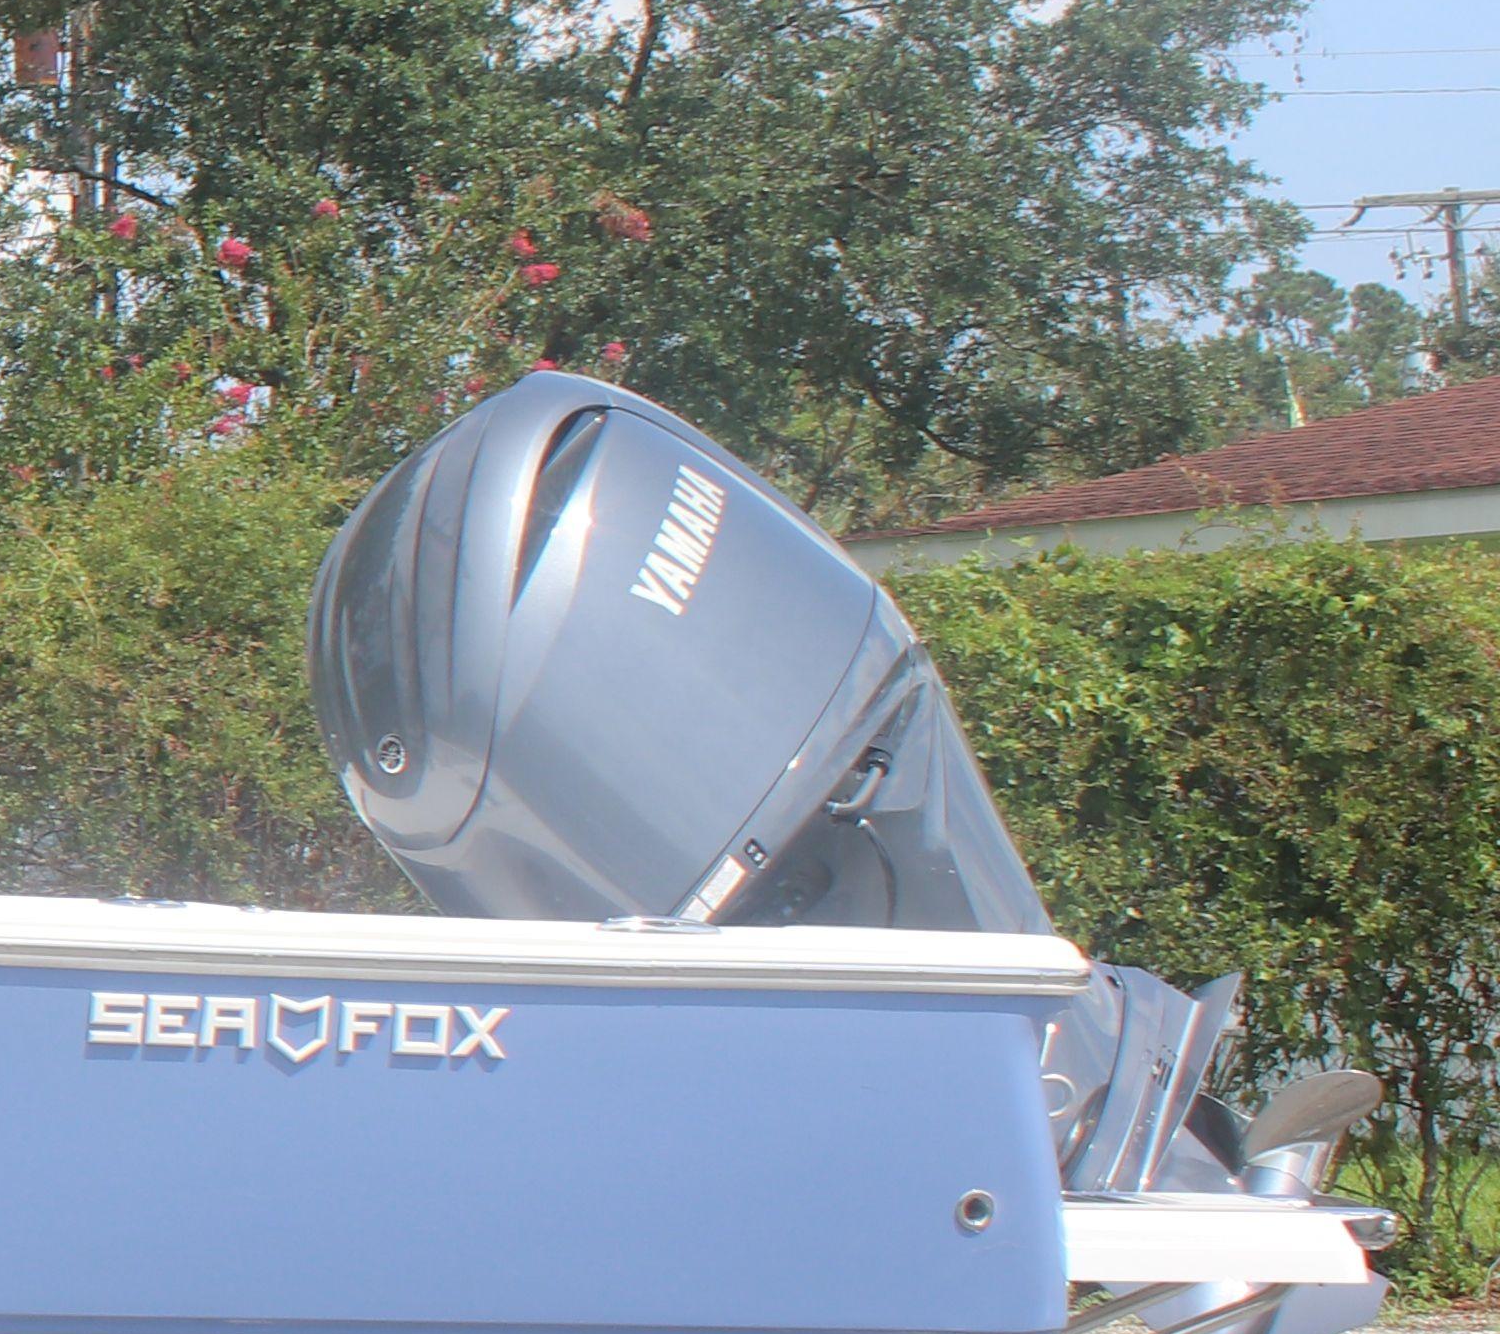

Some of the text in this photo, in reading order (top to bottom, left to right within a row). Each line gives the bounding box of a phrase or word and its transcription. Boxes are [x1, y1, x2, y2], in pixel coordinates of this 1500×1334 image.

[630, 465, 726, 616] YAMAHA
[88, 991, 511, 1059] SEA FOX
